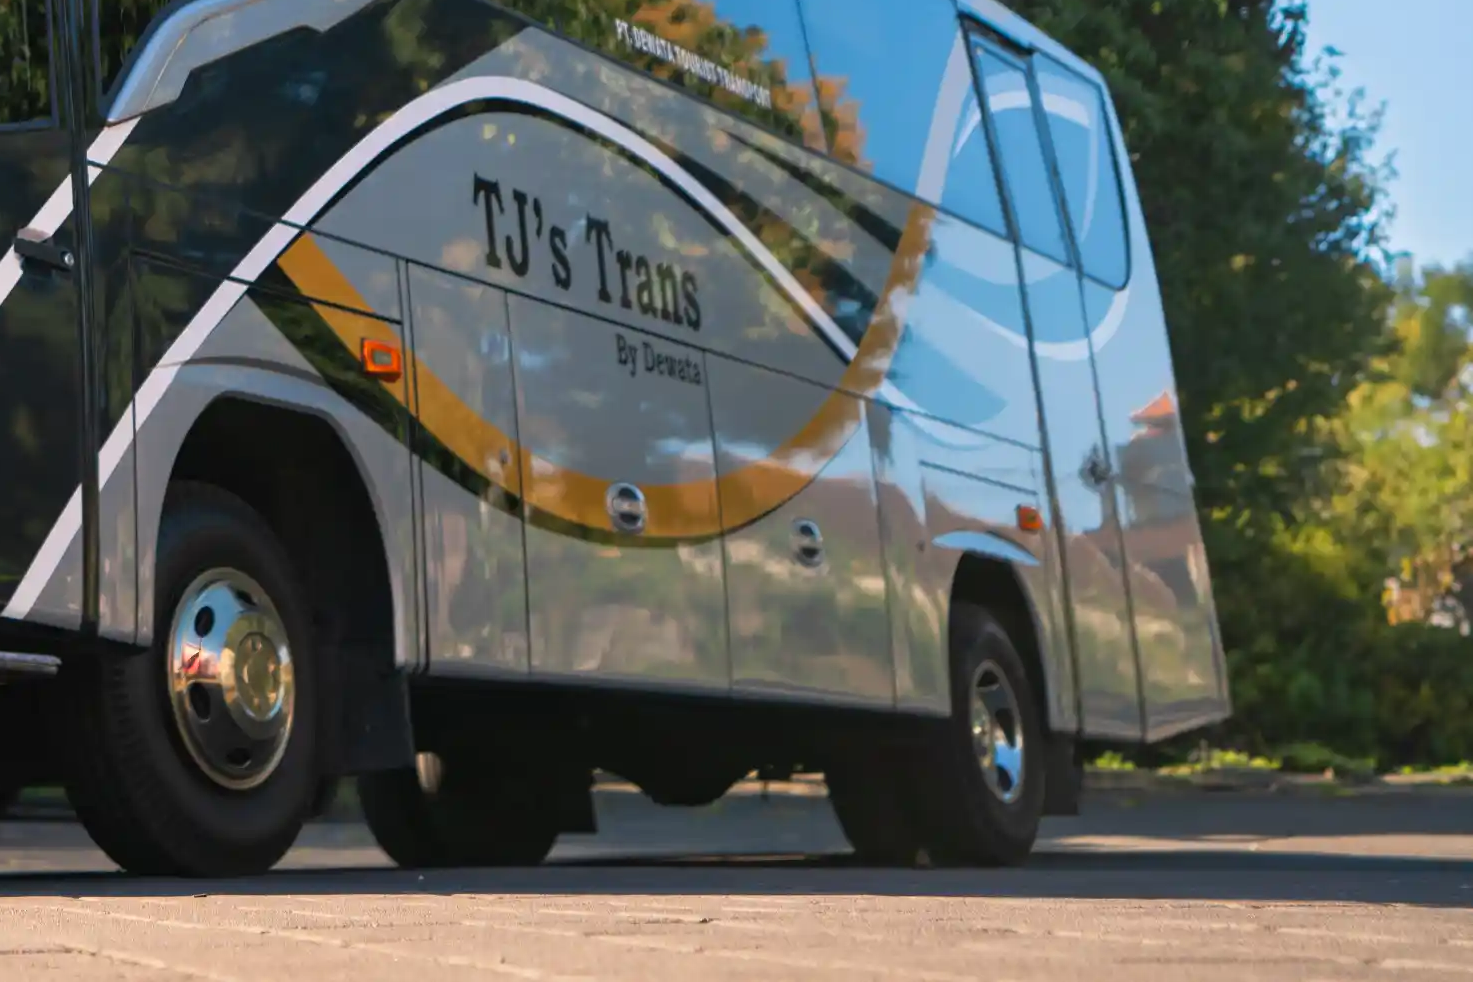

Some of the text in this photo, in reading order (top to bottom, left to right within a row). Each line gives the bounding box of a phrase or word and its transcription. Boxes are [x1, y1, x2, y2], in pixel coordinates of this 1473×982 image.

[632, 25, 676, 63] DEWATA
[473, 172, 703, 332] TJ's Trans
[615, 332, 702, 386] By Dewata
